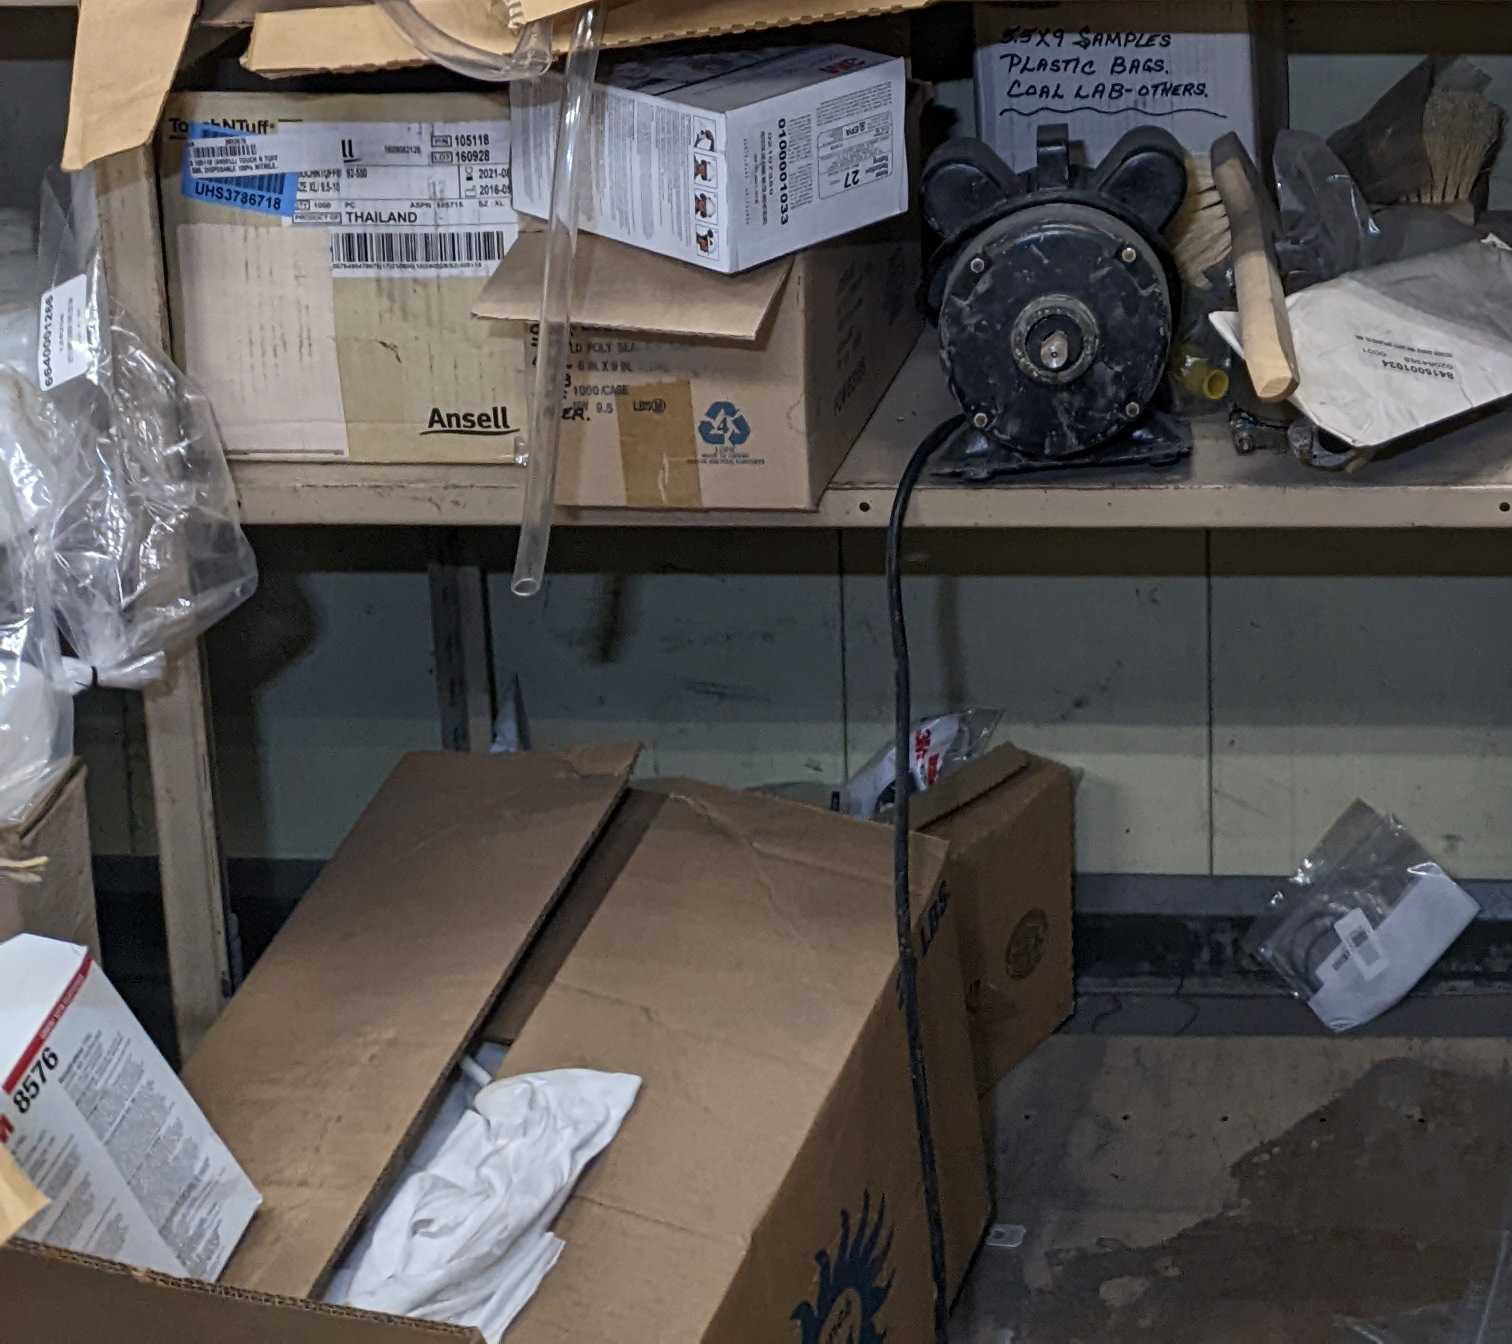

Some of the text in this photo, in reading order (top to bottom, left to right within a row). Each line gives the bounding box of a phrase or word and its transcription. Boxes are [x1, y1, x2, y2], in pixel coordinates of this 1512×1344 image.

[1072, 25, 1171, 50] SAMPLES
[1000, 53, 1169, 75] PLASTIC BAGS.
[1007, 80, 1208, 100] COAL LAB-OTHERS.
[454, 134, 490, 146] 105118
[455, 150, 490, 162] 160928
[778, 118, 789, 226] 0100001033
[843, 169, 860, 189] 27
[195, 182, 281, 210] UHS3786718
[346, 211, 418, 224] THAILAND
[427, 406, 508, 430] Ansell
[717, 417, 729, 434] 4
[12, 1046, 60, 1115] 8576
